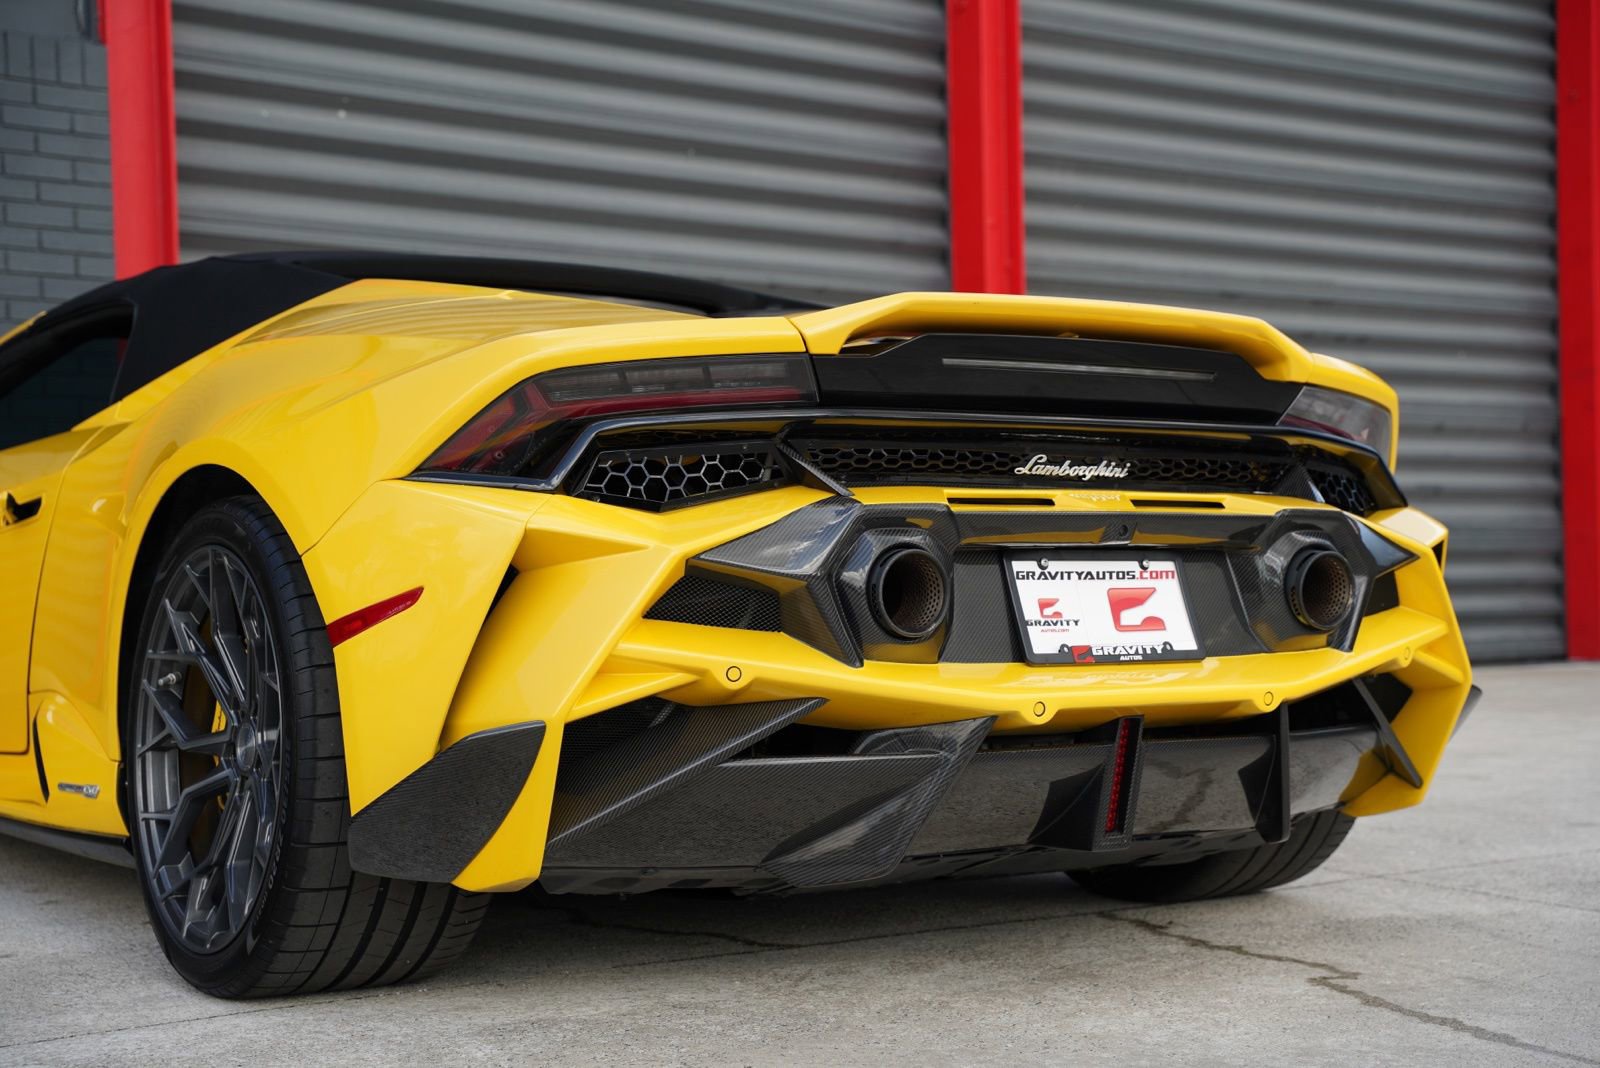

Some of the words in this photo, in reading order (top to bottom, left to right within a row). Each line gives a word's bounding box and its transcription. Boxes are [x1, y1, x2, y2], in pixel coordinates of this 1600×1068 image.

[1014, 454, 1131, 481] Lamborghini
[1026, 619, 1081, 627] GRAVITY
[1091, 645, 1165, 656] GRAVITY
